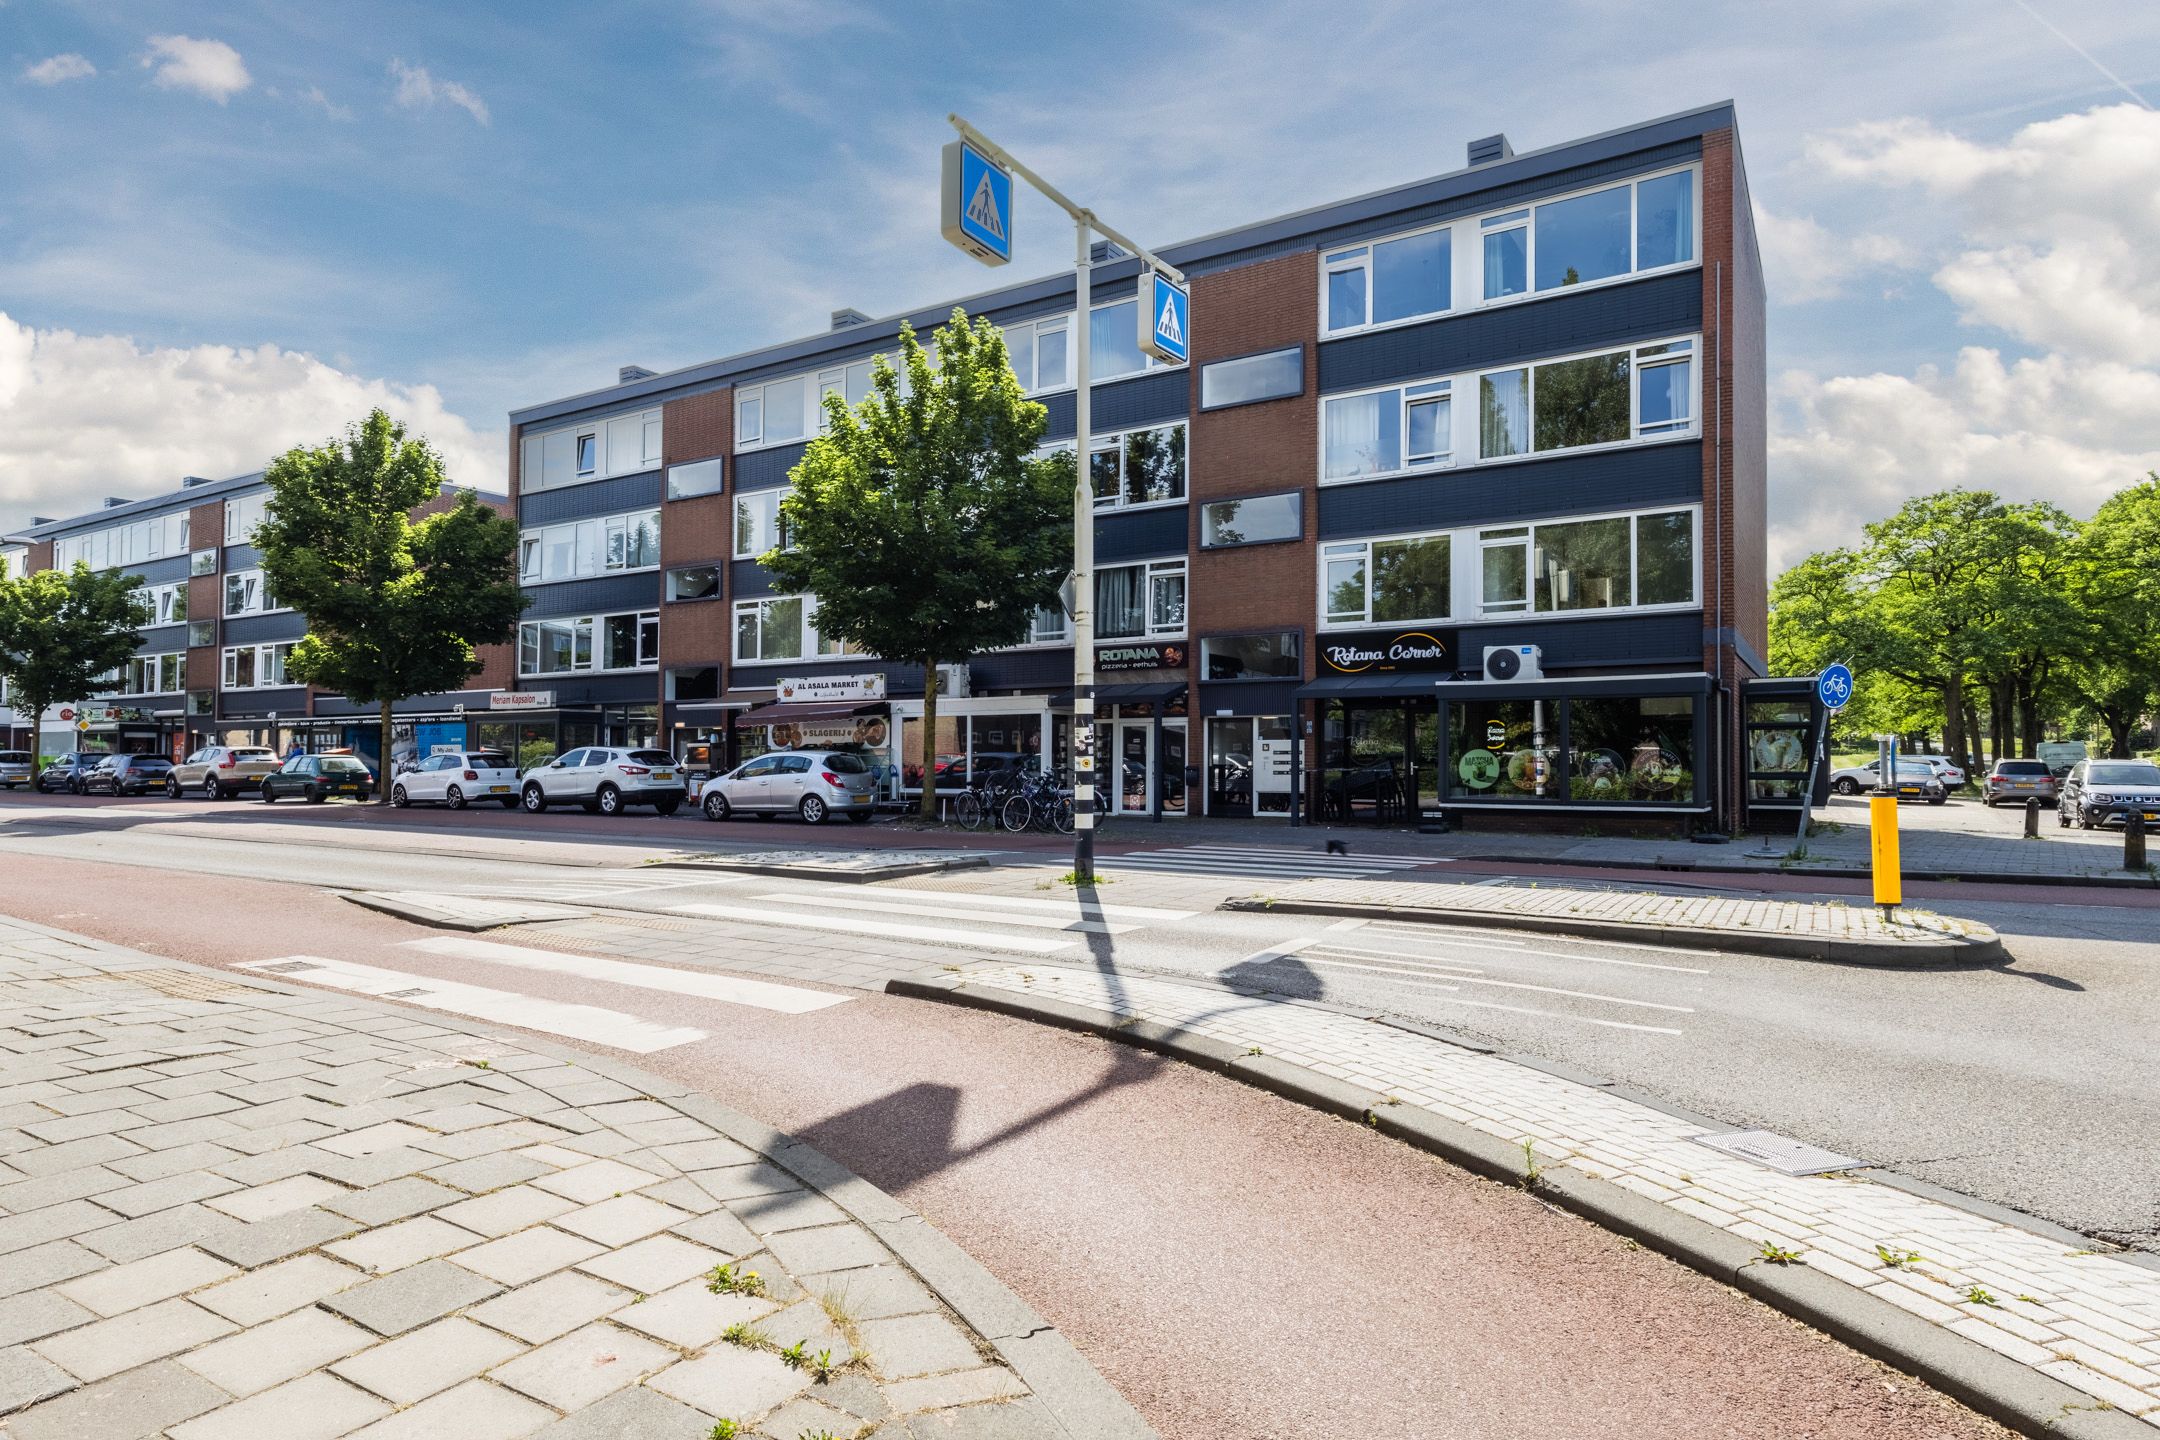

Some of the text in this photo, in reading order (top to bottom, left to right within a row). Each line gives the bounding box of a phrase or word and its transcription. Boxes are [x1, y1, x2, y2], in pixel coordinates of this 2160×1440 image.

[1099, 647, 1160, 662] ROTANA
[1327, 644, 1442, 666] Rotana Corner
[1101, 662, 1128, 671] pizzeria
[831, 681, 859, 689] MARKET
[511, 694, 536, 706] Kapsalon
[808, 729, 846, 737] SLAGERIJ
